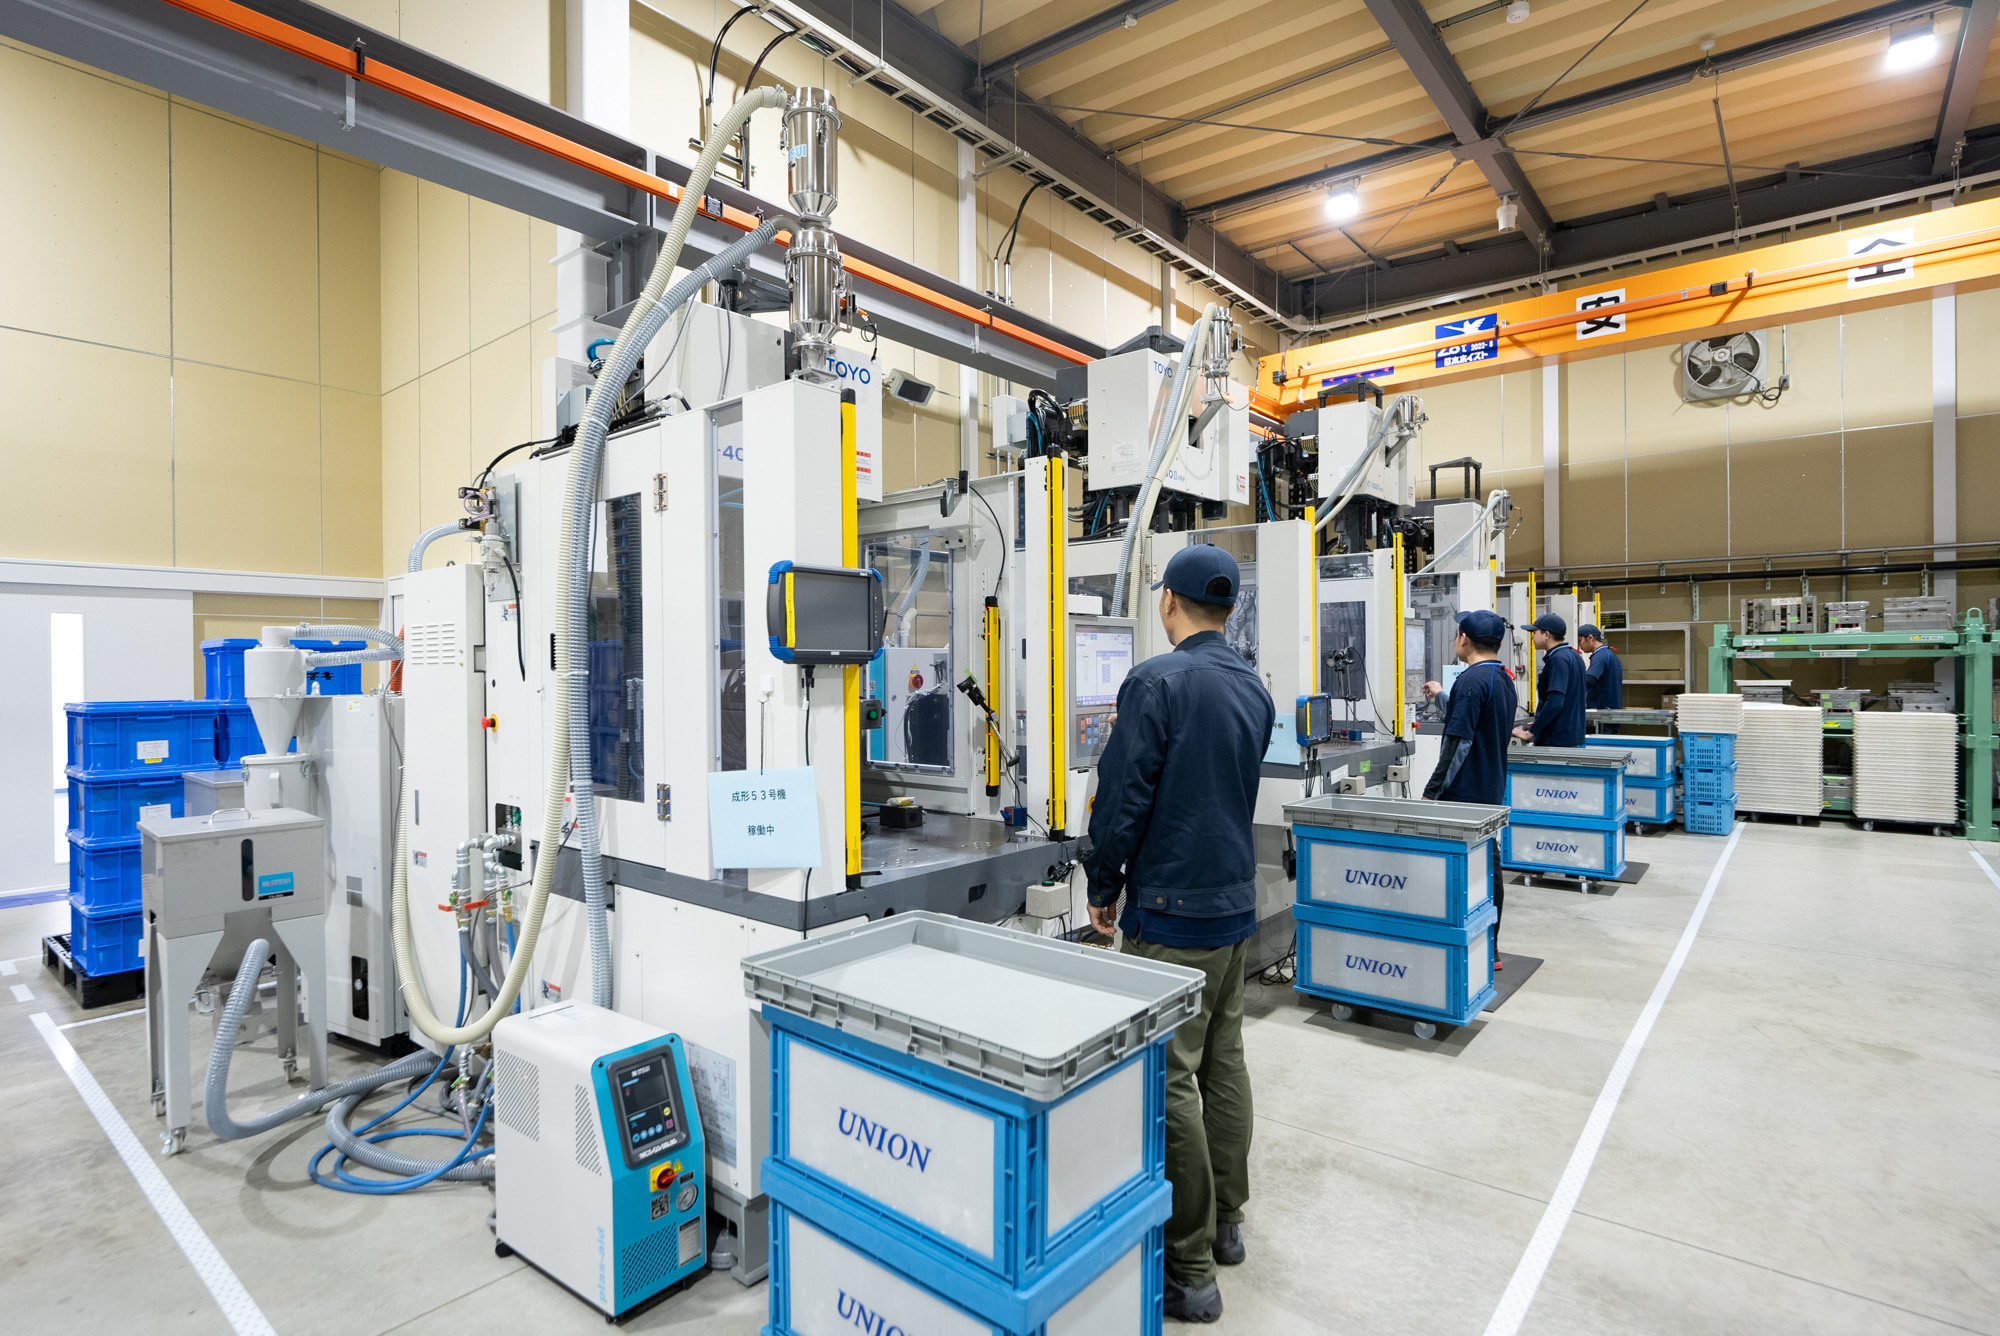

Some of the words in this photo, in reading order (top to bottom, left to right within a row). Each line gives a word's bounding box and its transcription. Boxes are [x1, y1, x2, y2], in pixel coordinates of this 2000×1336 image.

[1444, 351, 1488, 367] 日本ホイスト
[826, 357, 871, 384] TOYO
[1153, 361, 1173, 378] TOYO
[731, 788, 787, 802] 成形53号機
[1535, 788, 1578, 800] UNION
[747, 824, 775, 836] 稼働中
[1535, 841, 1579, 854] UNION
[1345, 869, 1408, 890] UNION
[1345, 954, 1408, 979] UNION
[838, 1106, 932, 1173] UNION
[837, 1288, 911, 1336] UNI
